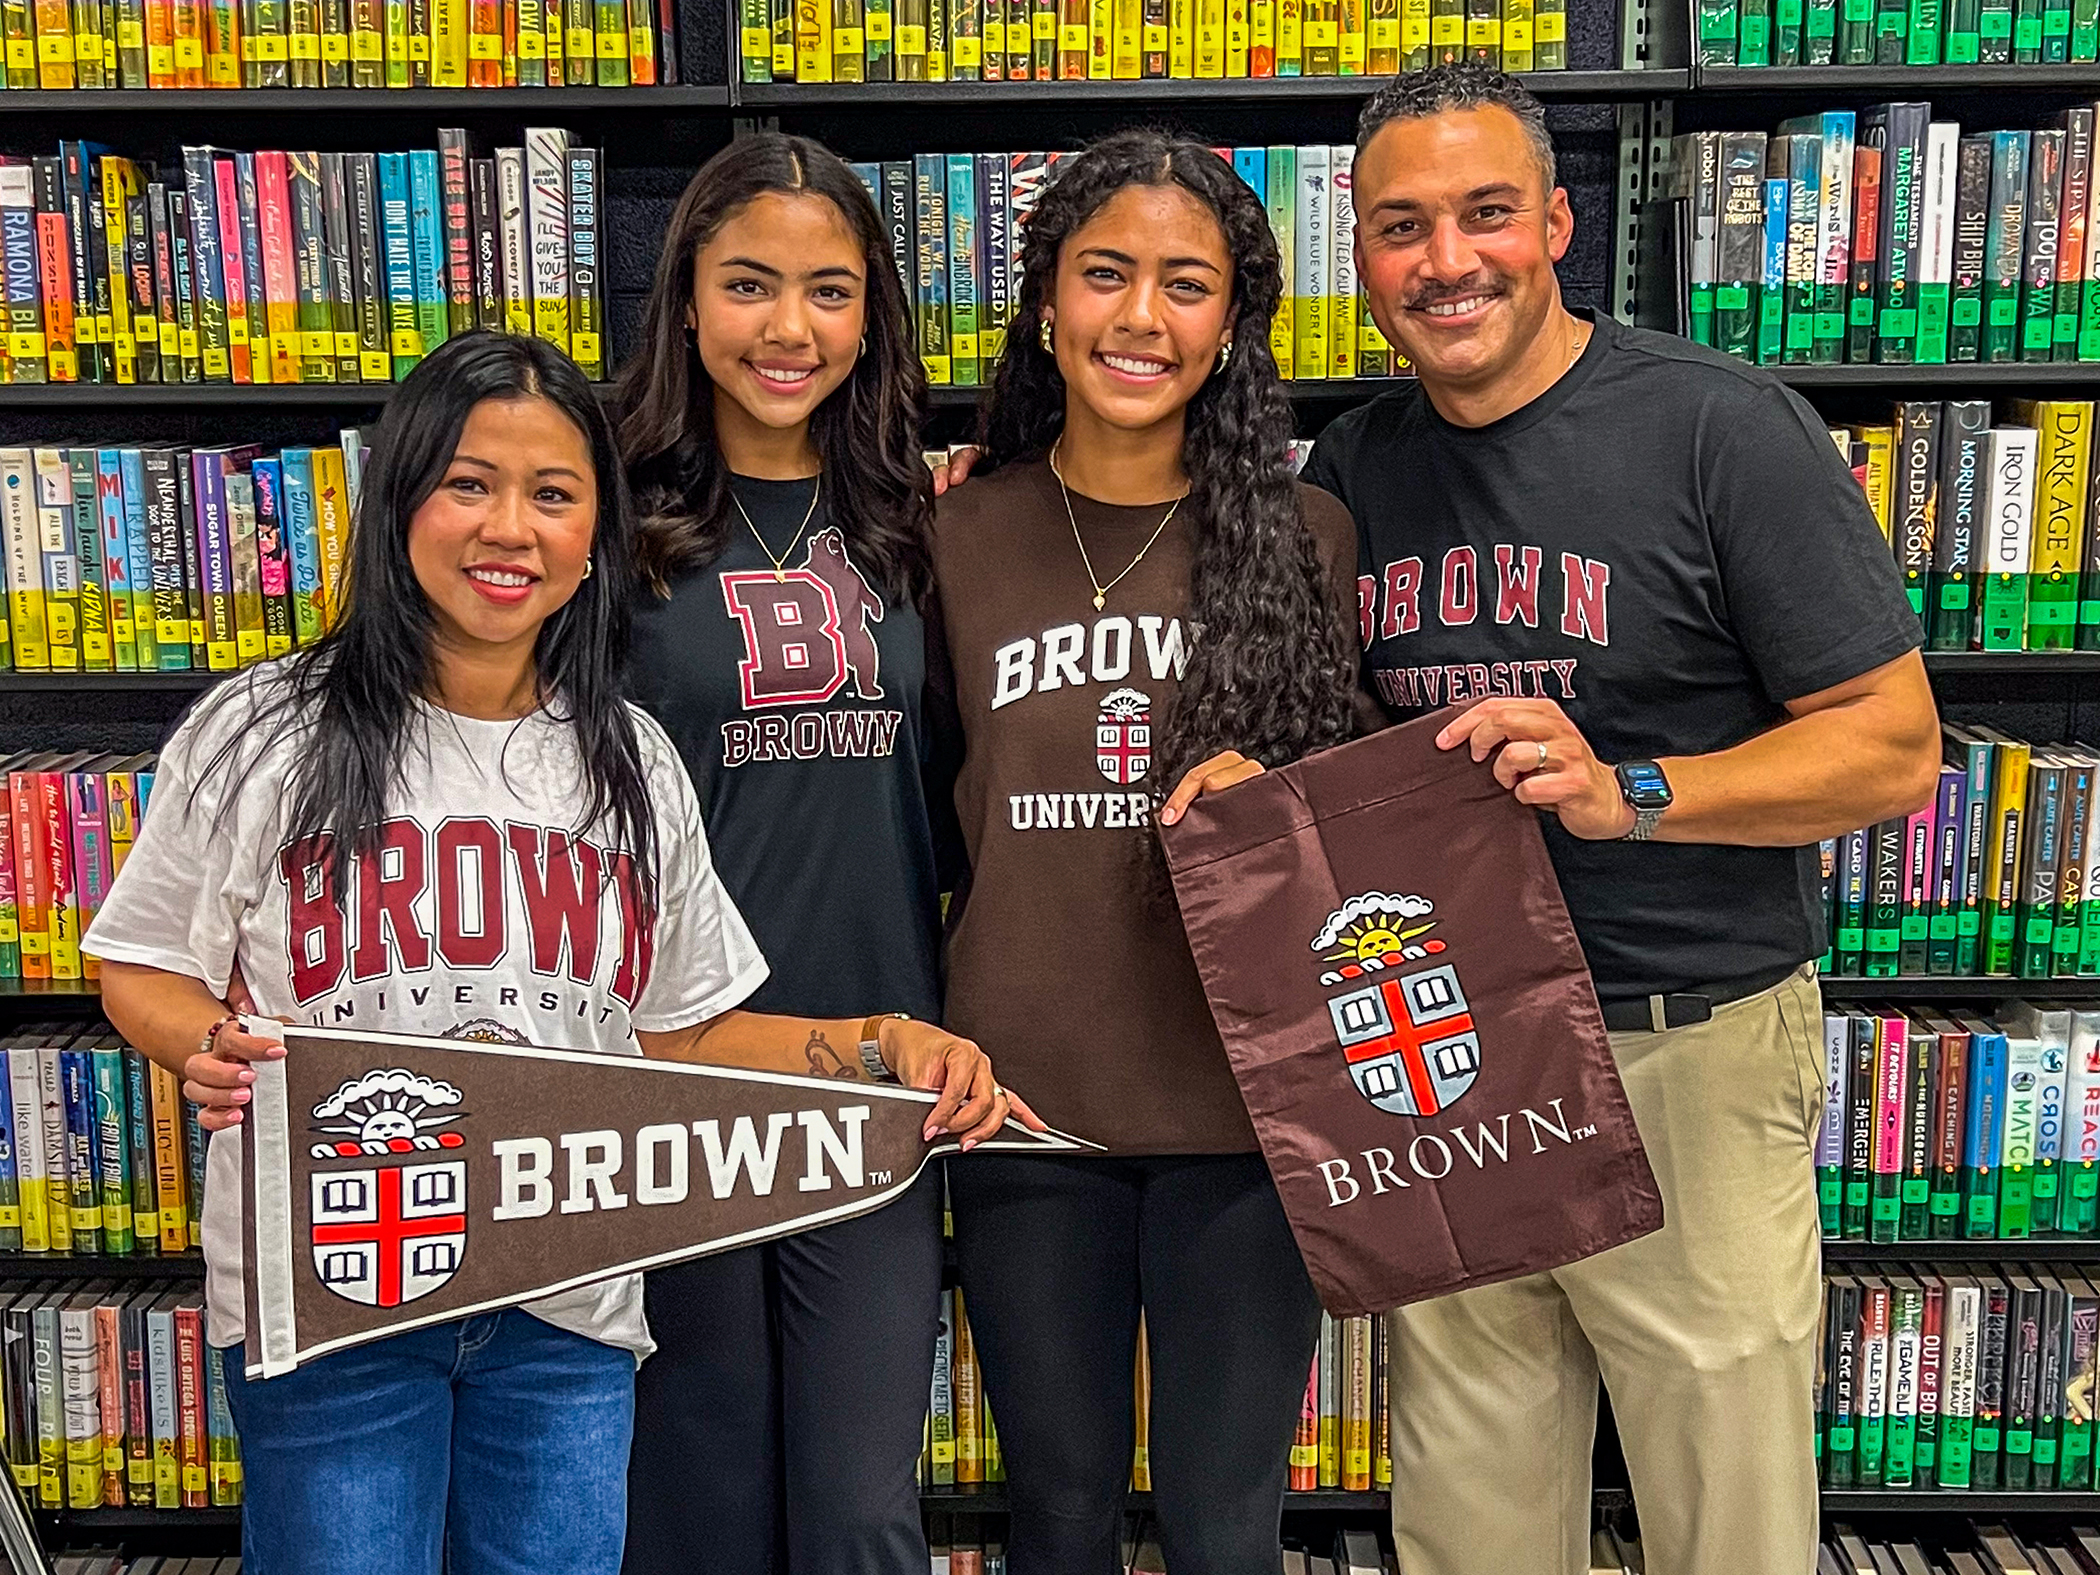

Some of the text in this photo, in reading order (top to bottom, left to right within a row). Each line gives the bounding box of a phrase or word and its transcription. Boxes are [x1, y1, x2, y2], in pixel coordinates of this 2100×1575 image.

[989, 171, 1003, 206] THE
[1701, 145, 1715, 184] robot
[386, 200, 408, 234] DON'T
[571, 159, 594, 226] SKATER
[1893, 147, 1912, 242] MARGARET
[1908, 180, 1921, 249] TESTAMENTS
[444, 146, 472, 305] TAKE NO NAMES
[891, 190, 905, 256] JUST CALL
[918, 175, 932, 287] RULE THE WORLD
[931, 192, 944, 270] TONIGHT WE
[991, 211, 1004, 249] WAY
[1790, 222, 1803, 243] OF
[1803, 222, 1817, 249] THE
[1959, 211, 1985, 246] SHIP
[2030, 217, 2058, 265] TOOL
[3, 211, 34, 302] RAMONA
[388, 238, 410, 266] HATE
[417, 236, 435, 301] TREMENDOUS
[508, 229, 523, 313] recovery road
[535, 243, 561, 255] GIVE
[536, 261, 561, 276] YOU
[573, 230, 594, 267] BOY
[1310, 196, 1320, 329] WILD BLUE WONDER
[1336, 242, 1350, 264] TED
[391, 268, 412, 291] THE
[538, 280, 560, 294] THE
[992, 266, 1005, 312] USED
[1336, 268, 1350, 319] CALLAHAN
[539, 301, 561, 313] SUN
[1869, 461, 1881, 481] ALL
[2044, 412, 2081, 551] DARK AGE
[157, 478, 176, 563] NEANDERTHAL
[323, 502, 335, 531] HOW
[1904, 438, 1929, 566] GOLDEN SON
[1949, 440, 1976, 573] MORNING STAR
[1999, 446, 2025, 563] IRON GOLD
[127, 498, 150, 593] TRAPPED
[206, 503, 223, 593] SUGAR TOWN
[296, 542, 306, 559] as
[327, 535, 339, 560] YOU
[82, 581, 102, 634] KIDNA
[152, 565, 172, 621] UNIVERS
[719, 568, 849, 711] B
[991, 616, 1193, 711] BROW
[1375, 658, 1578, 707] UNIVERSITY
[721, 711, 903, 768] BROWN
[1009, 792, 1150, 831] UNIVER
[1850, 838, 1862, 873] CARD
[2005, 819, 2017, 866] MANNERS
[1877, 831, 1899, 920] WAKERS
[278, 815, 658, 1014] BROWN
[1831, 1037, 1839, 1074] COHN
[1890, 1042, 1899, 1052] IT
[16, 1102, 33, 1180] like water
[157, 1118, 171, 1152] LUCY
[1853, 1098, 1870, 1176] EMERGENT
[1945, 1087, 1958, 1149] CATCHING
[492, 1105, 891, 1221] BROWN TM
[1316, 1098, 1598, 1207] BROWN TM
[153, 1328, 166, 1366] kids
[1840, 1329, 1854, 1351] THE
[1870, 1342, 1883, 1378] RULE
[1953, 1346, 1963, 1376] MORE
[34, 1338, 52, 1395] FOUR
[1839, 1355, 1852, 1378] EYE
[1898, 1345, 1913, 1393] GAME
[1918, 1334, 1941, 1437] OUT OF BODY
[181, 1339, 196, 1459] LUIS ORTEGA SURVIVAL
